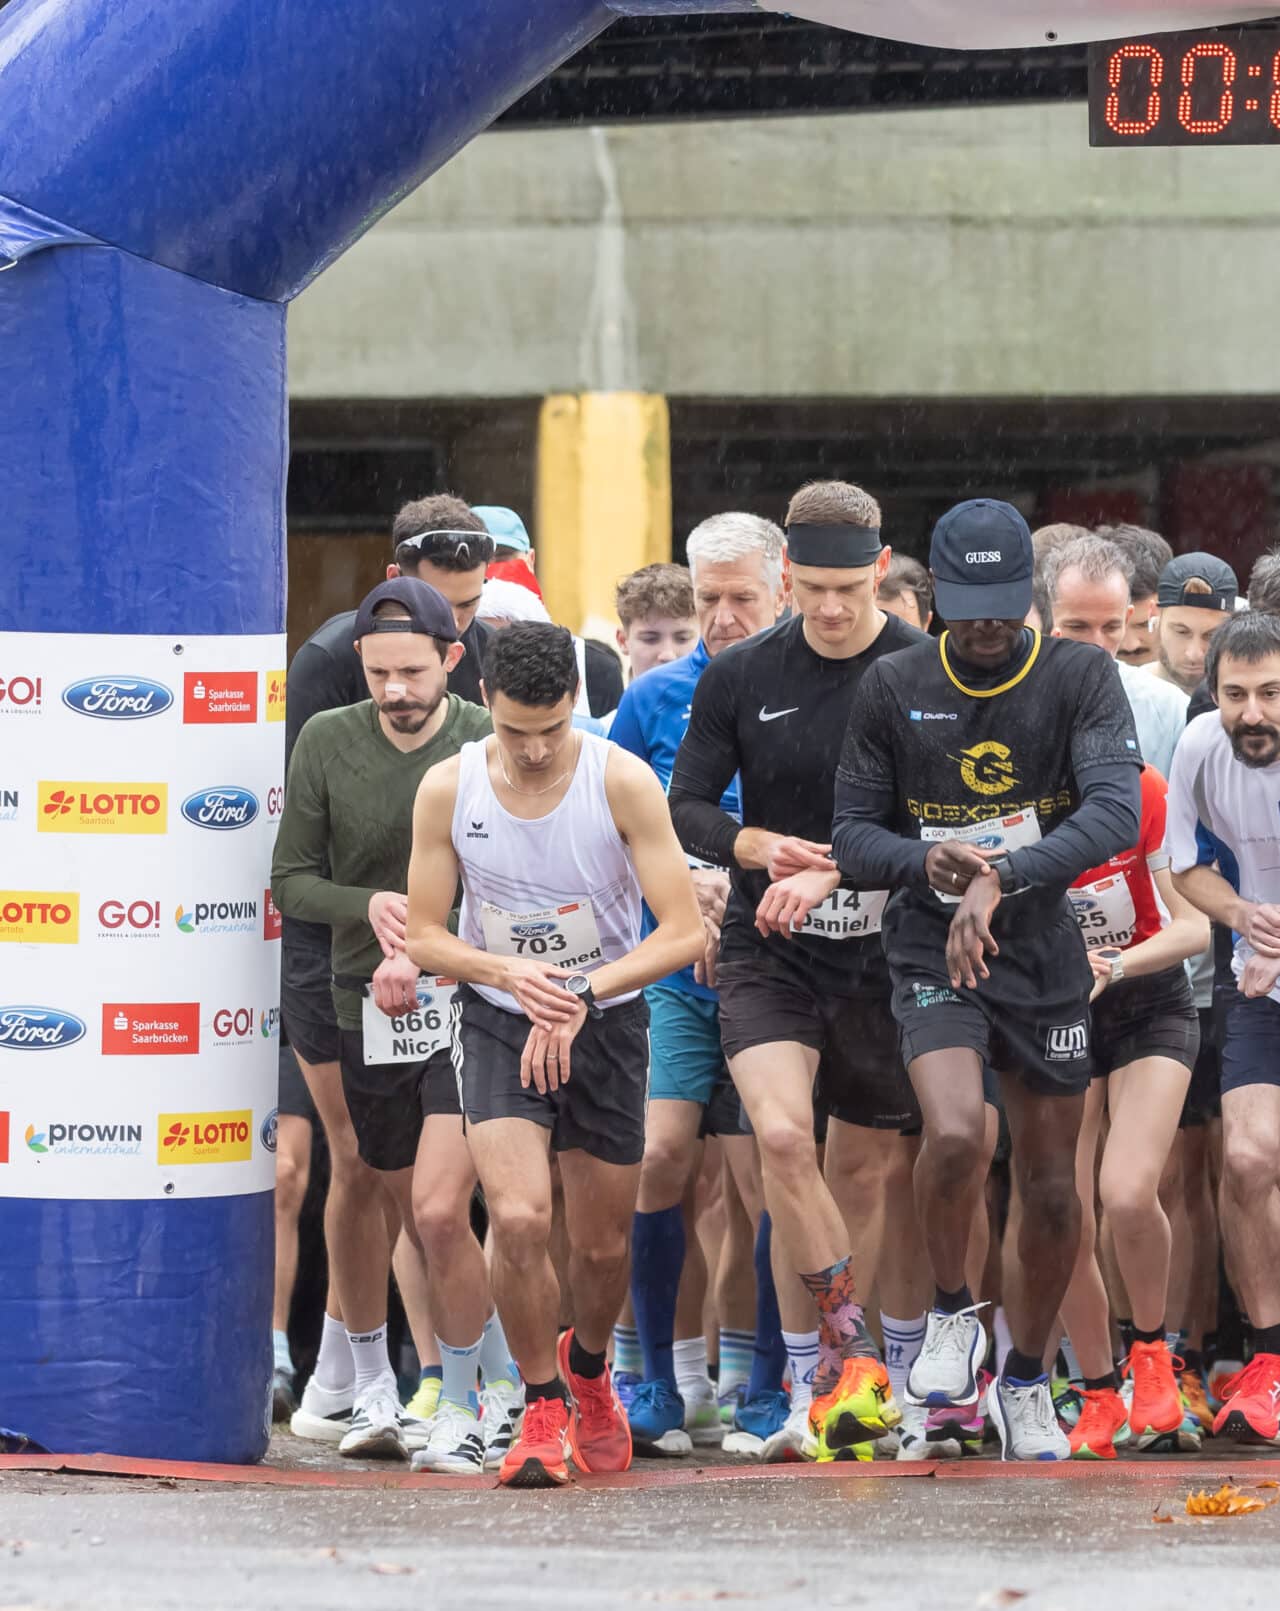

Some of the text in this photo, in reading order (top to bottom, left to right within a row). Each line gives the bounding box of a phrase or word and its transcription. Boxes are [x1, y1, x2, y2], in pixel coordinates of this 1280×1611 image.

[965, 550, 1001, 564] GUESS
[0, 676, 42, 705] O!
[83, 681, 153, 713] Ford
[208, 689, 245, 700] Sparkasse
[208, 702, 251, 712] Saarbrücken
[79, 793, 161, 815] LOTTO
[198, 794, 248, 823] Ford
[812, 890, 861, 912] 14
[0, 902, 72, 925] OTTO
[98, 900, 160, 929] GO!
[510, 933, 567, 955] 703
[1086, 922, 1135, 946] arin
[553, 947, 602, 969] med
[0, 1012, 64, 1043] Ford
[132, 1020, 179, 1032] Sparkasse
[213, 1008, 254, 1038] GO!
[391, 1009, 442, 1034] 666
[132, 1033, 189, 1044] Saarbrücken
[194, 1121, 249, 1145] LOTTO
[350, 1332, 383, 1343] cep
